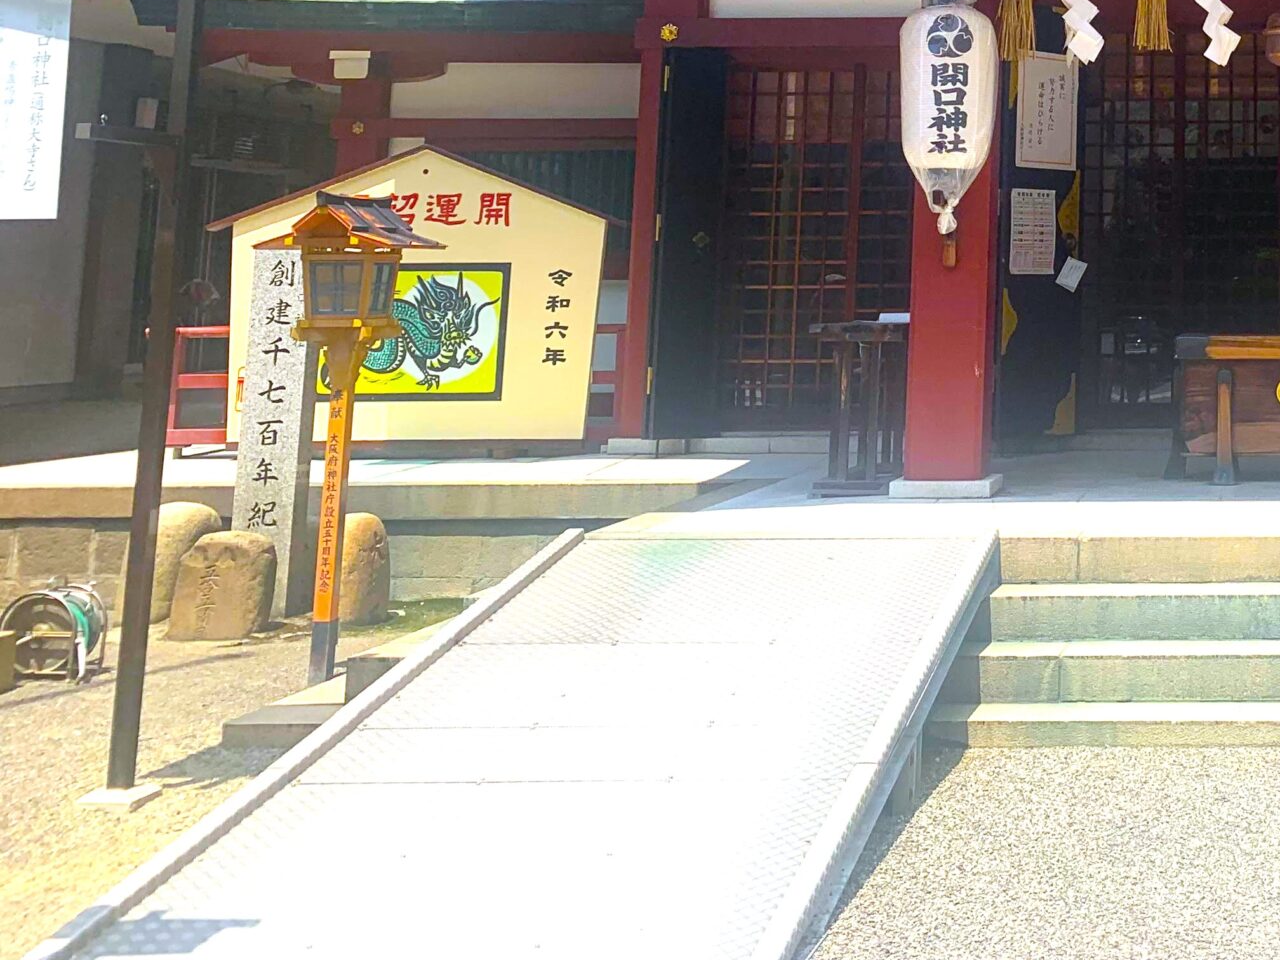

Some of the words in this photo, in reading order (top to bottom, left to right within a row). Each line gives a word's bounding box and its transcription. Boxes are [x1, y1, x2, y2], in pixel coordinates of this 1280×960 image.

[927, 62, 969, 154] 開口神社
[541, 269, 573, 366] 令和六年
[247, 259, 296, 529] 創建千七百年紀
